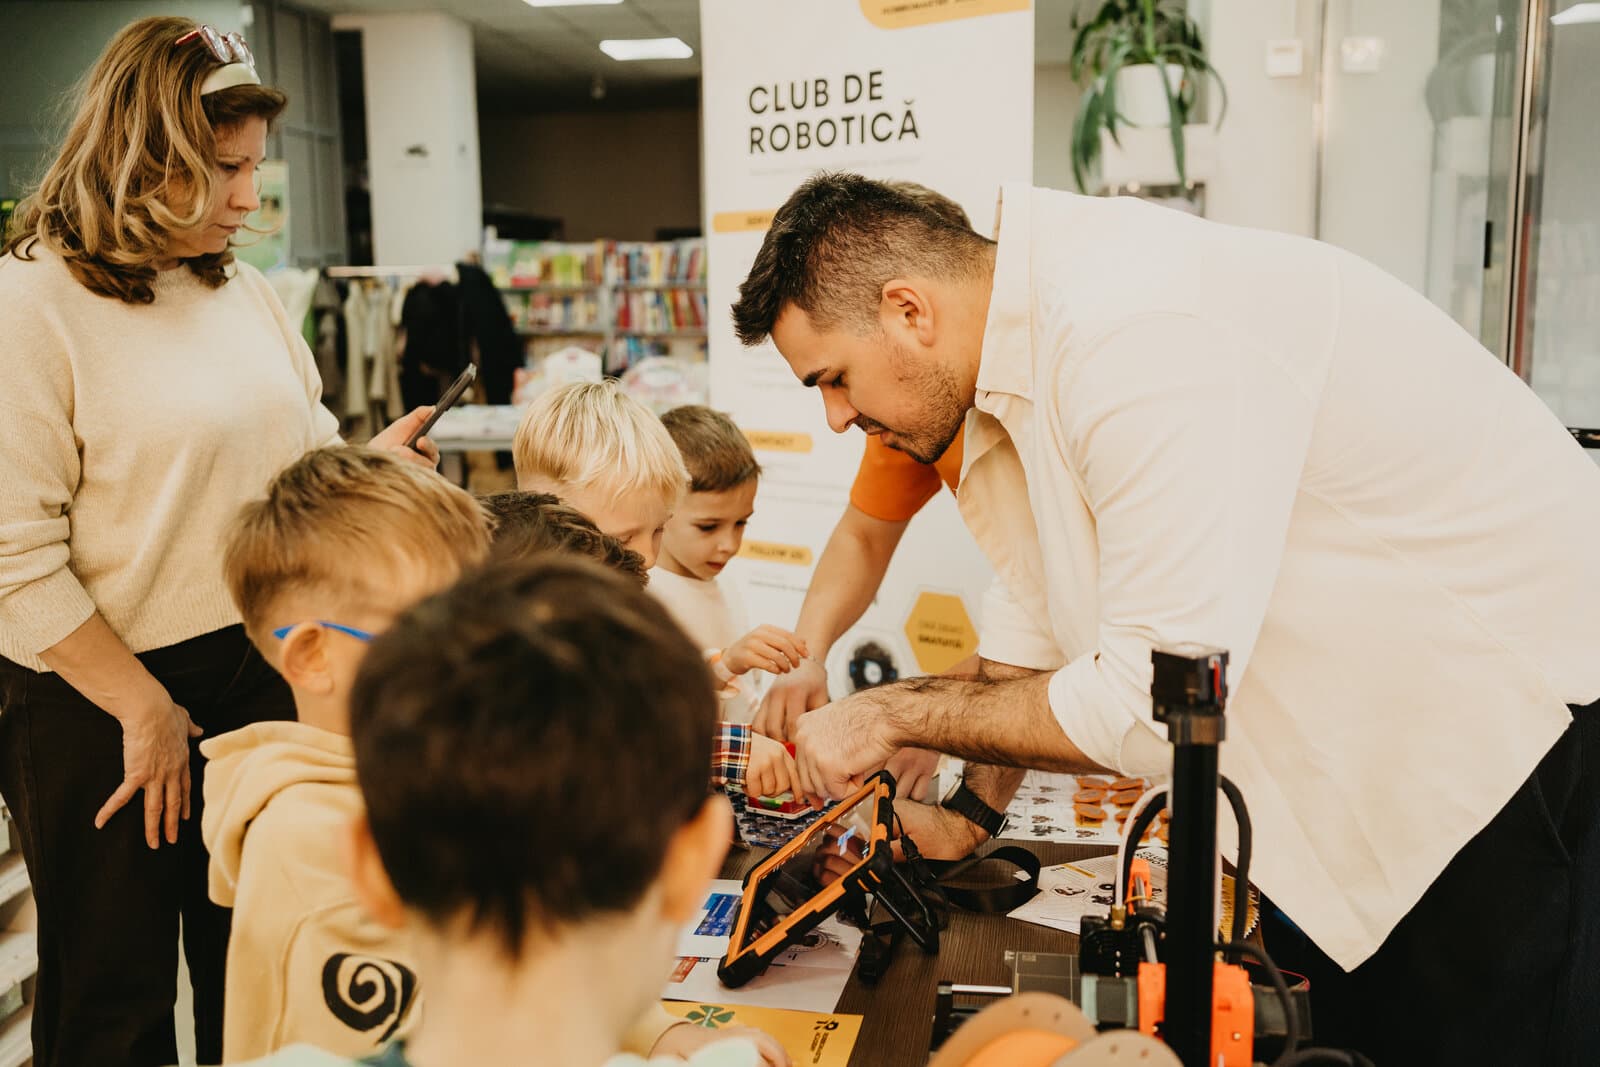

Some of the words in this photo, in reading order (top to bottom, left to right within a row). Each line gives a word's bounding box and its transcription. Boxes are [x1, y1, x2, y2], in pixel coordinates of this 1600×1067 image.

[749, 79, 829, 115] CLUB
[844, 71, 883, 104] DE
[749, 99, 919, 154] ROBOTICĂ
